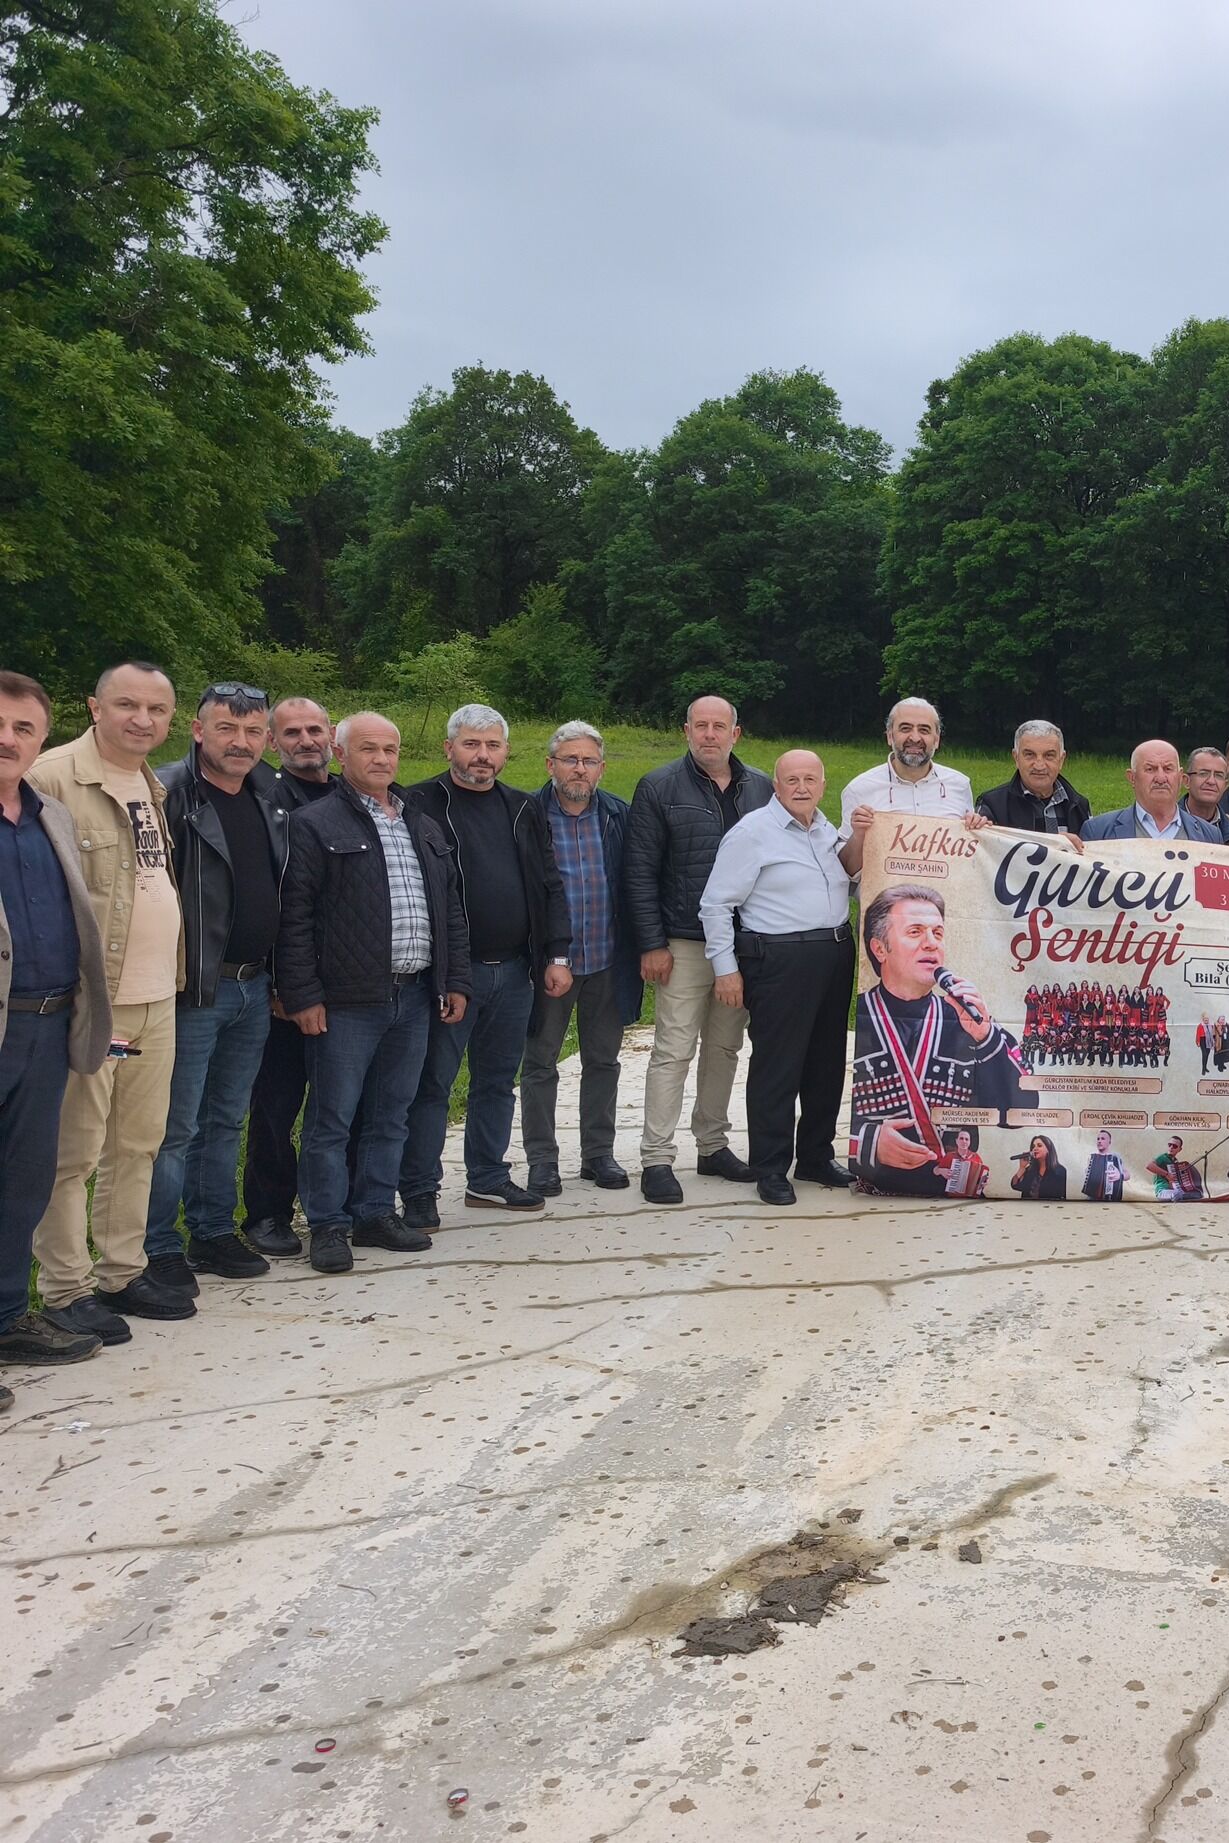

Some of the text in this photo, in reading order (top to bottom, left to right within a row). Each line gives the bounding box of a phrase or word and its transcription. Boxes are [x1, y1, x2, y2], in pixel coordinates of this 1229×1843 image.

[889, 823, 979, 860] Kafkas
[890, 861, 944, 873] BAYAR ŞAHİN
[1201, 867, 1218, 879] 30
[1010, 906, 1185, 989] Şenliği
[1195, 972, 1221, 984] Bila
